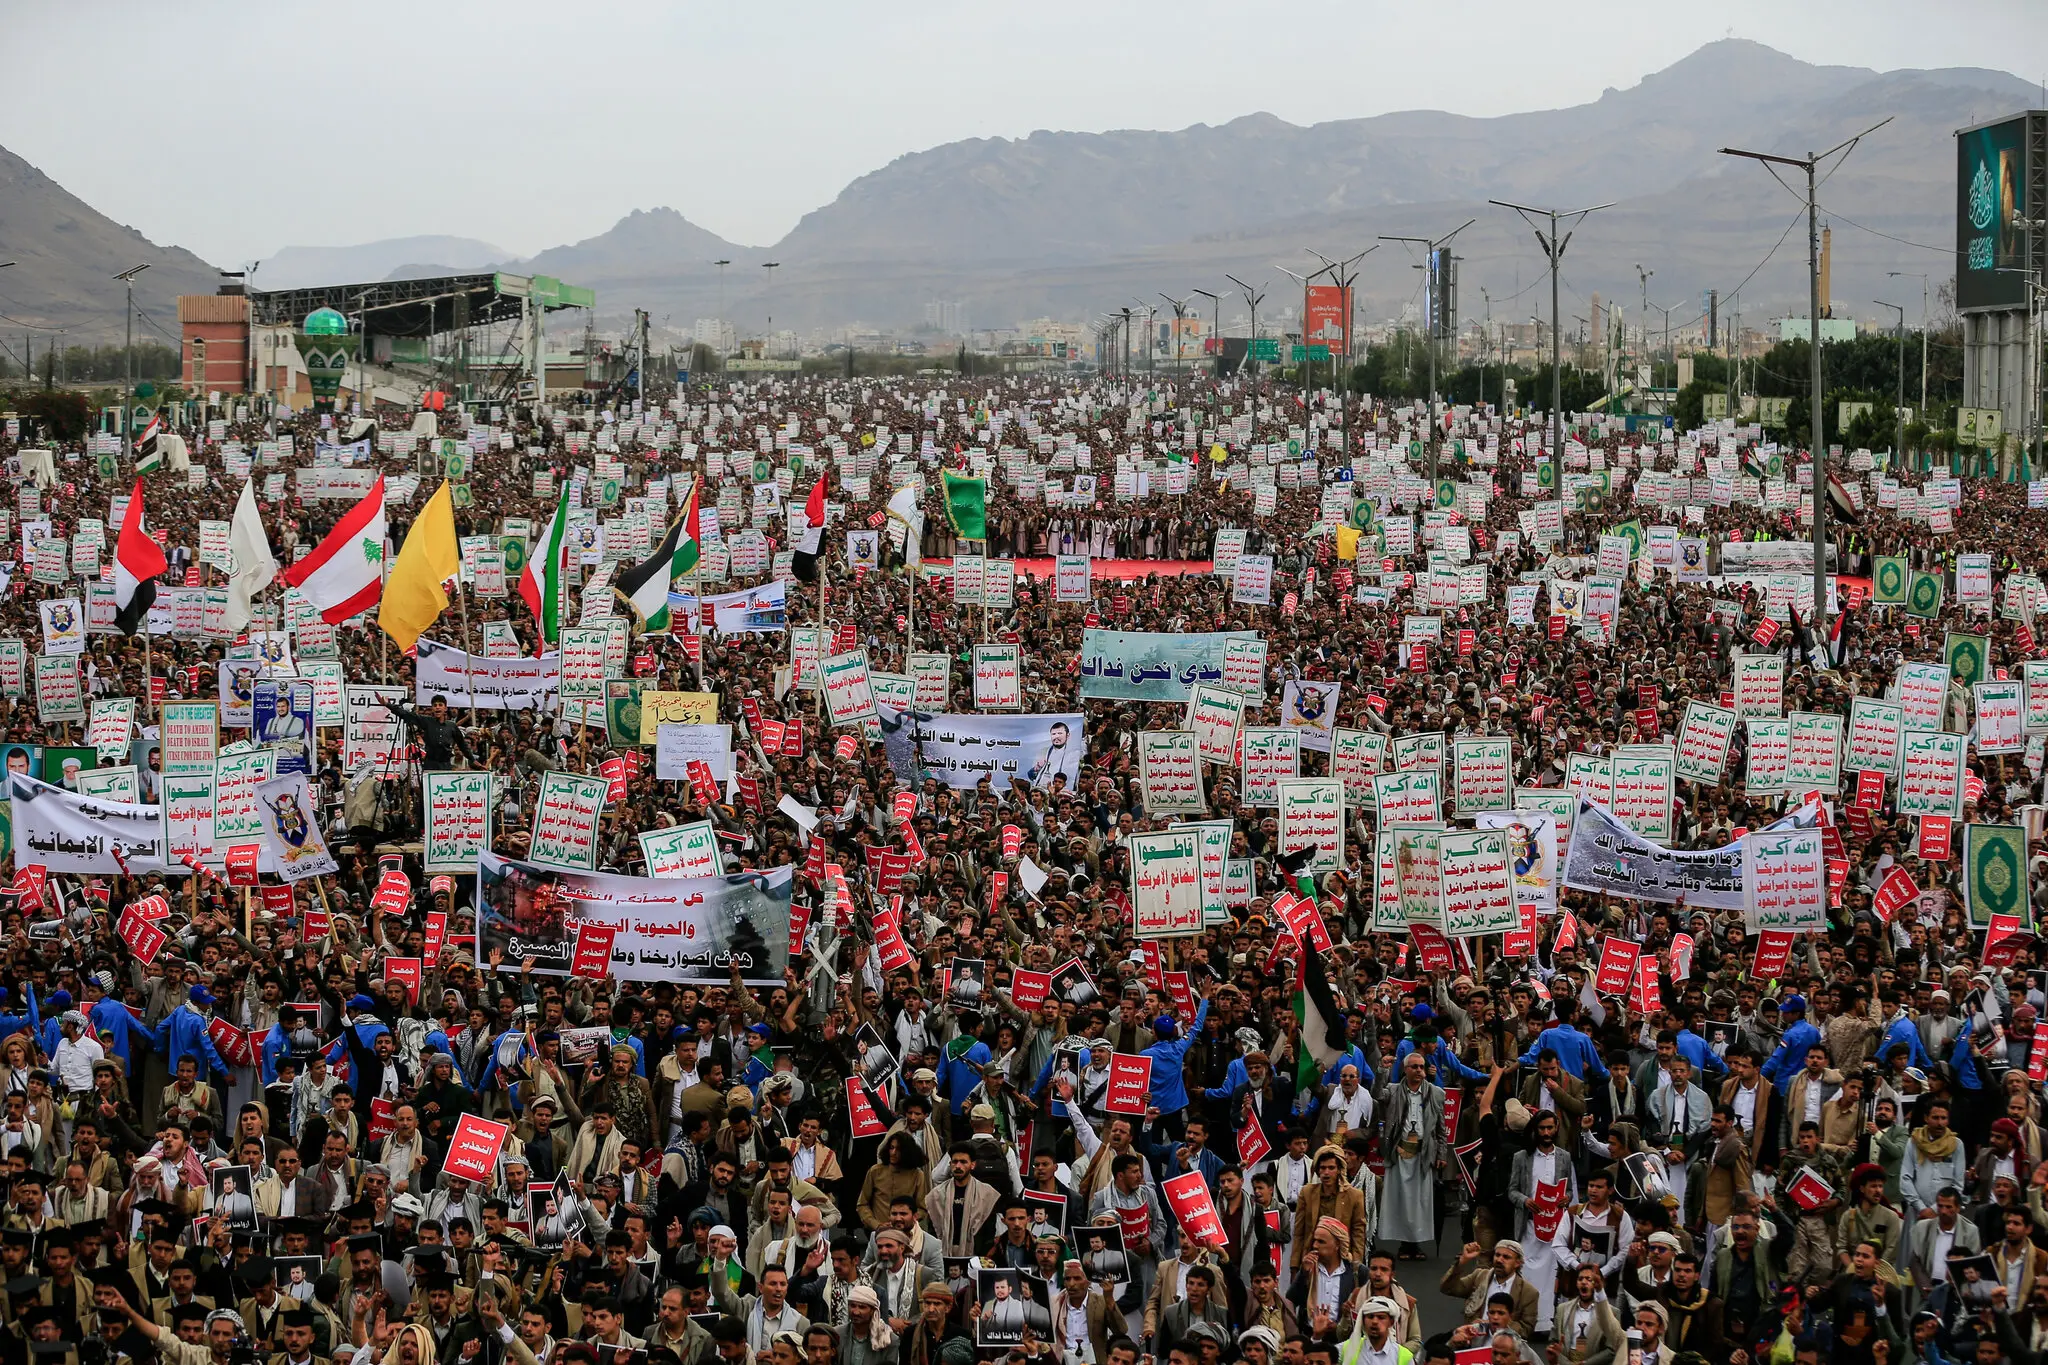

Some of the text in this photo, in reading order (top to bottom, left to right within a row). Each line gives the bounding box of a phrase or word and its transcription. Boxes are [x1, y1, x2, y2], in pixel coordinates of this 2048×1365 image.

[491, 665, 500, 678] أن
[822, 655, 863, 677] قاطعوا
[1081, 656, 1221, 690] يدي نحن فداك
[503, 668, 539, 680] السعودي
[452, 684, 463, 694] في
[167, 725, 213, 734] DEATH TO AMERICA
[940, 732, 955, 742] لك
[167, 738, 209, 746] DEATH TO ISRAEL
[959, 734, 981, 746] نحن
[985, 738, 1021, 750] سيدي
[250, 756, 269, 769] الله
[960, 759, 1017, 772] لك الجنود
[217, 804, 237, 817] اليهود
[217, 818, 245, 834] للإسلام
[1926, 821, 1946, 830] جمعة
[27, 829, 104, 860] الإيمانية
[1594, 833, 1613, 849] الله
[1615, 838, 1649, 858] سبيل
[1756, 837, 1792, 860] أكبر
[1794, 838, 1817, 854] الله
[1138, 837, 1193, 866] قاطعوا
[1443, 836, 1505, 862] الله أكبر
[230, 859, 252, 868] التحذير
[1444, 860, 1506, 876] الموت لأمريكا
[1756, 860, 1817, 876] الموت لأمريكا
[387, 876, 408, 886] جمعة
[1137, 866, 1198, 890] البضائع الأمريكية
[1592, 864, 1635, 883] الموقف
[1446, 880, 1478, 895] لإسرائيل
[1480, 878, 1508, 891] الموت
[1639, 876, 1658, 891] في
[1662, 871, 1700, 892] وتأثير
[1757, 878, 1818, 893] الموت لإسرائيل
[381, 889, 406, 897] التحذير
[683, 891, 704, 905] كل
[1165, 890, 1170, 905] و
[1448, 896, 1510, 913] اللعنة على اليهود
[1758, 894, 1819, 908] اللعنة على اليهود
[1140, 909, 1200, 929] الإسرائيلية
[1292, 909, 1311, 924] جمعة
[1450, 911, 1513, 932] النصر للإسلام
[1760, 909, 1820, 926] النصر للإسلام
[634, 918, 695, 939] والحيوية
[584, 933, 608, 944] جمعة
[1766, 938, 1788, 946] جمعة
[580, 947, 606, 958] التحذير
[639, 948, 711, 969] لصواريخنا
[714, 952, 752, 968] هدف
[1609, 946, 1632, 960] جمعة
[578, 961, 602, 973] والنفير
[1604, 962, 1630, 972] التحذير
[1759, 965, 1780, 973] والنفير
[1602, 976, 1625, 987] والنفير
[1117, 1062, 1145, 1074] جمعة
[1114, 1079, 1143, 1089] التحذير
[1113, 1094, 1140, 1107] والنفير
[466, 1124, 496, 1141] جمعة
[459, 1141, 492, 1155] التحذير
[454, 1157, 485, 1173] والنفير
[1176, 1184, 1204, 1200] جمعة
[1184, 1201, 1212, 1223] التحذير
[1194, 1223, 1219, 1240] والنفير
[987, 1331, 1001, 1339] فداك
